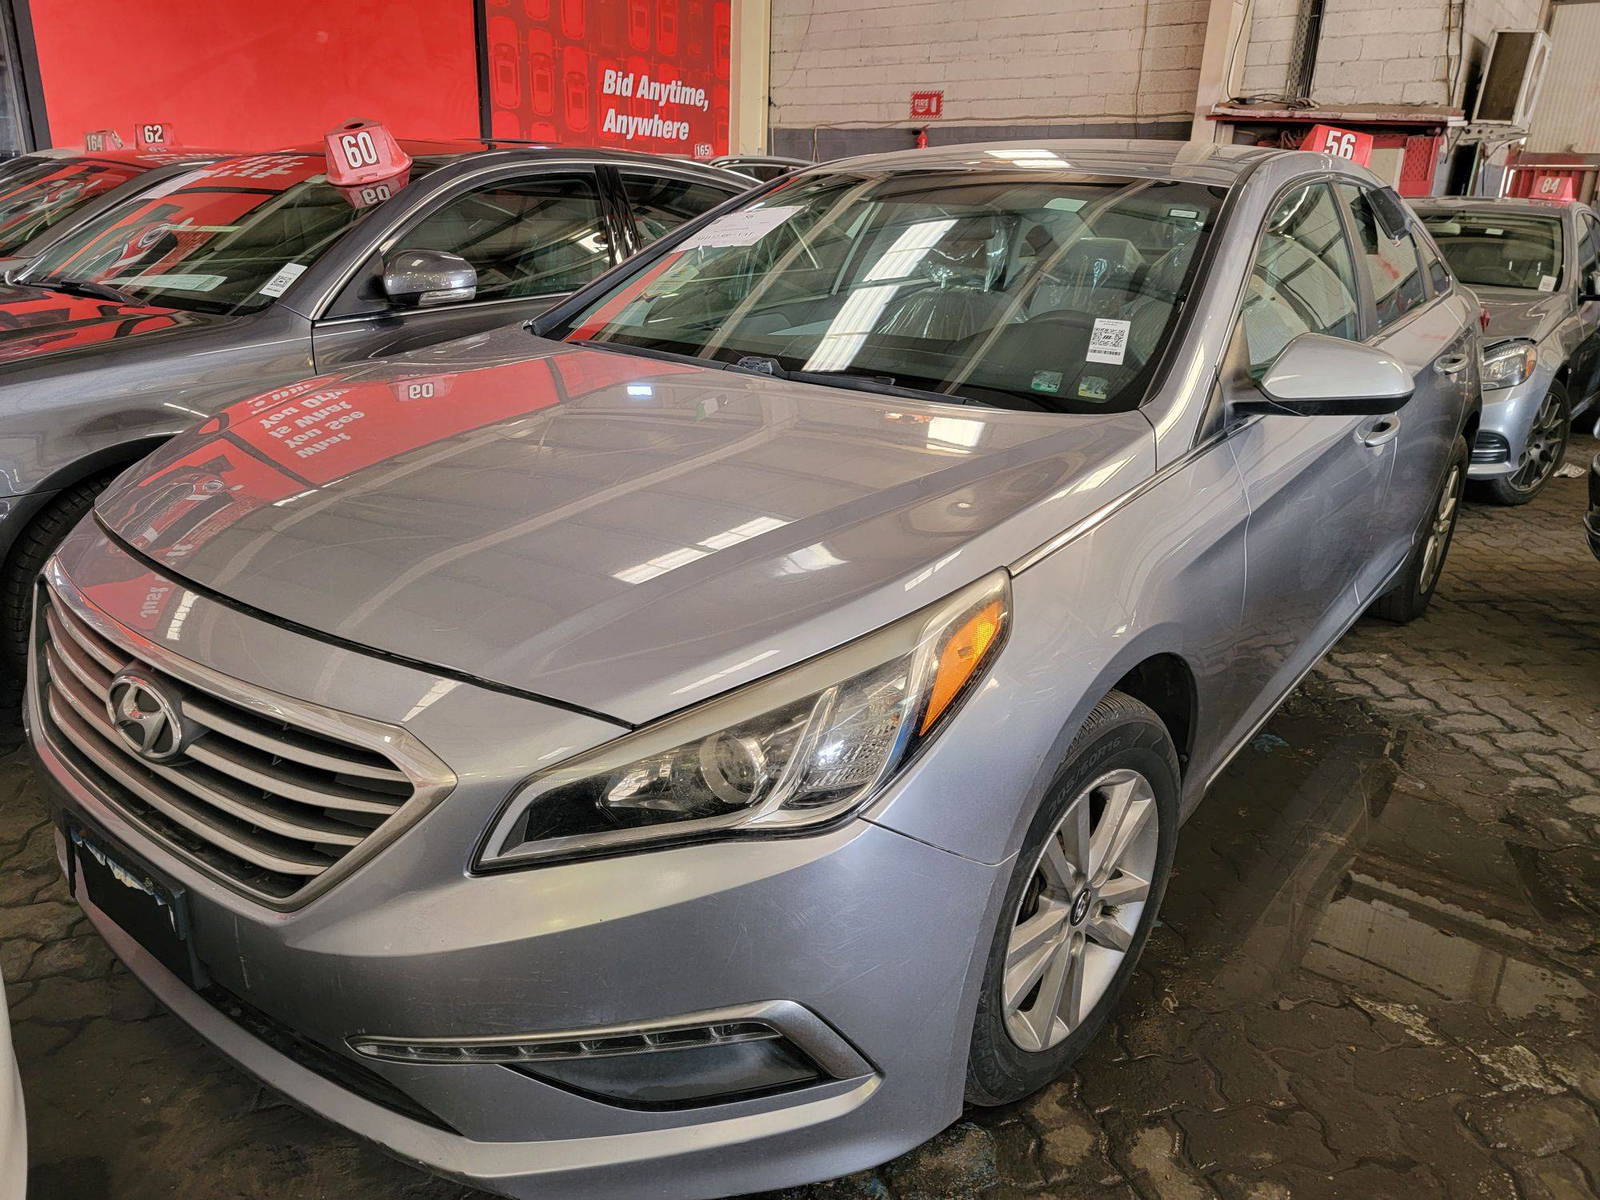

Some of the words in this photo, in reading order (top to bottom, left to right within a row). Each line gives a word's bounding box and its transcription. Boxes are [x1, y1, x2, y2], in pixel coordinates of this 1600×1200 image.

[603, 69, 634, 97] Bid
[636, 75, 709, 111] Anytime,
[143, 124, 163, 144] 62
[603, 108, 689, 141] Anywhere
[341, 131, 377, 169] 60
[696, 145, 710, 157] 165
[1324, 130, 1356, 160] 56
[1540, 177, 1560, 194] 84
